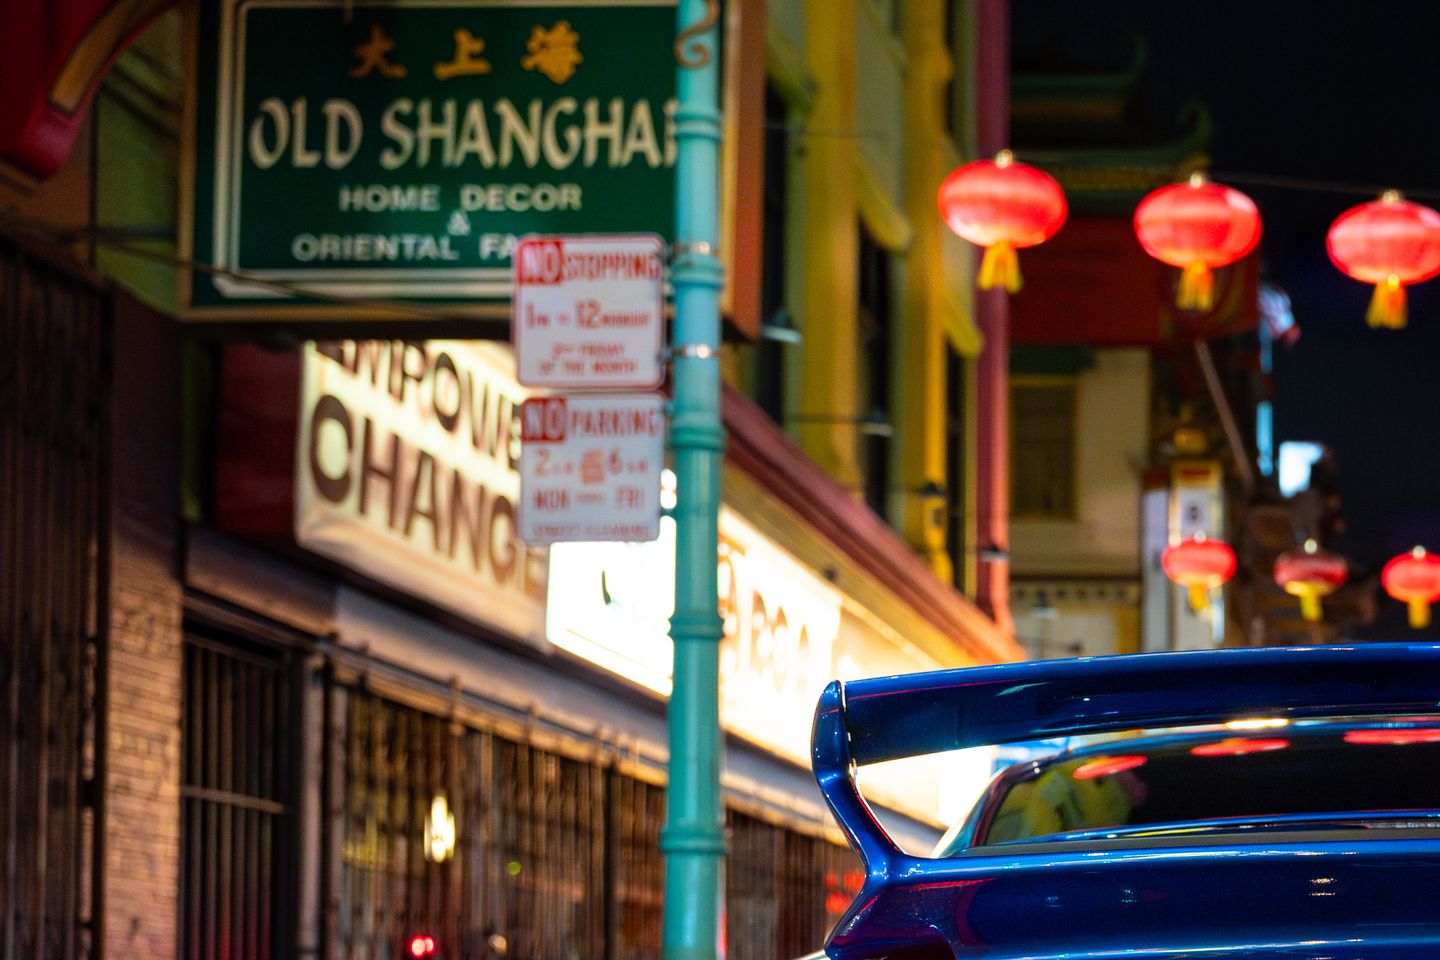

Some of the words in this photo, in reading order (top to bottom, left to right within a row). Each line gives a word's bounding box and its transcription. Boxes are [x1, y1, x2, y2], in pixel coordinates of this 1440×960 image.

[249, 97, 363, 170] OLD
[379, 96, 679, 170] SHANGHAI
[339, 184, 441, 212] HOME
[459, 183, 582, 212] DECOR
[447, 210, 470, 236] &
[291, 233, 460, 262] ORIENTAL
[521, 243, 560, 283] NO
[563, 253, 661, 280] STOPPING
[526, 400, 565, 439] NO
[571, 410, 660, 437] PARKING
